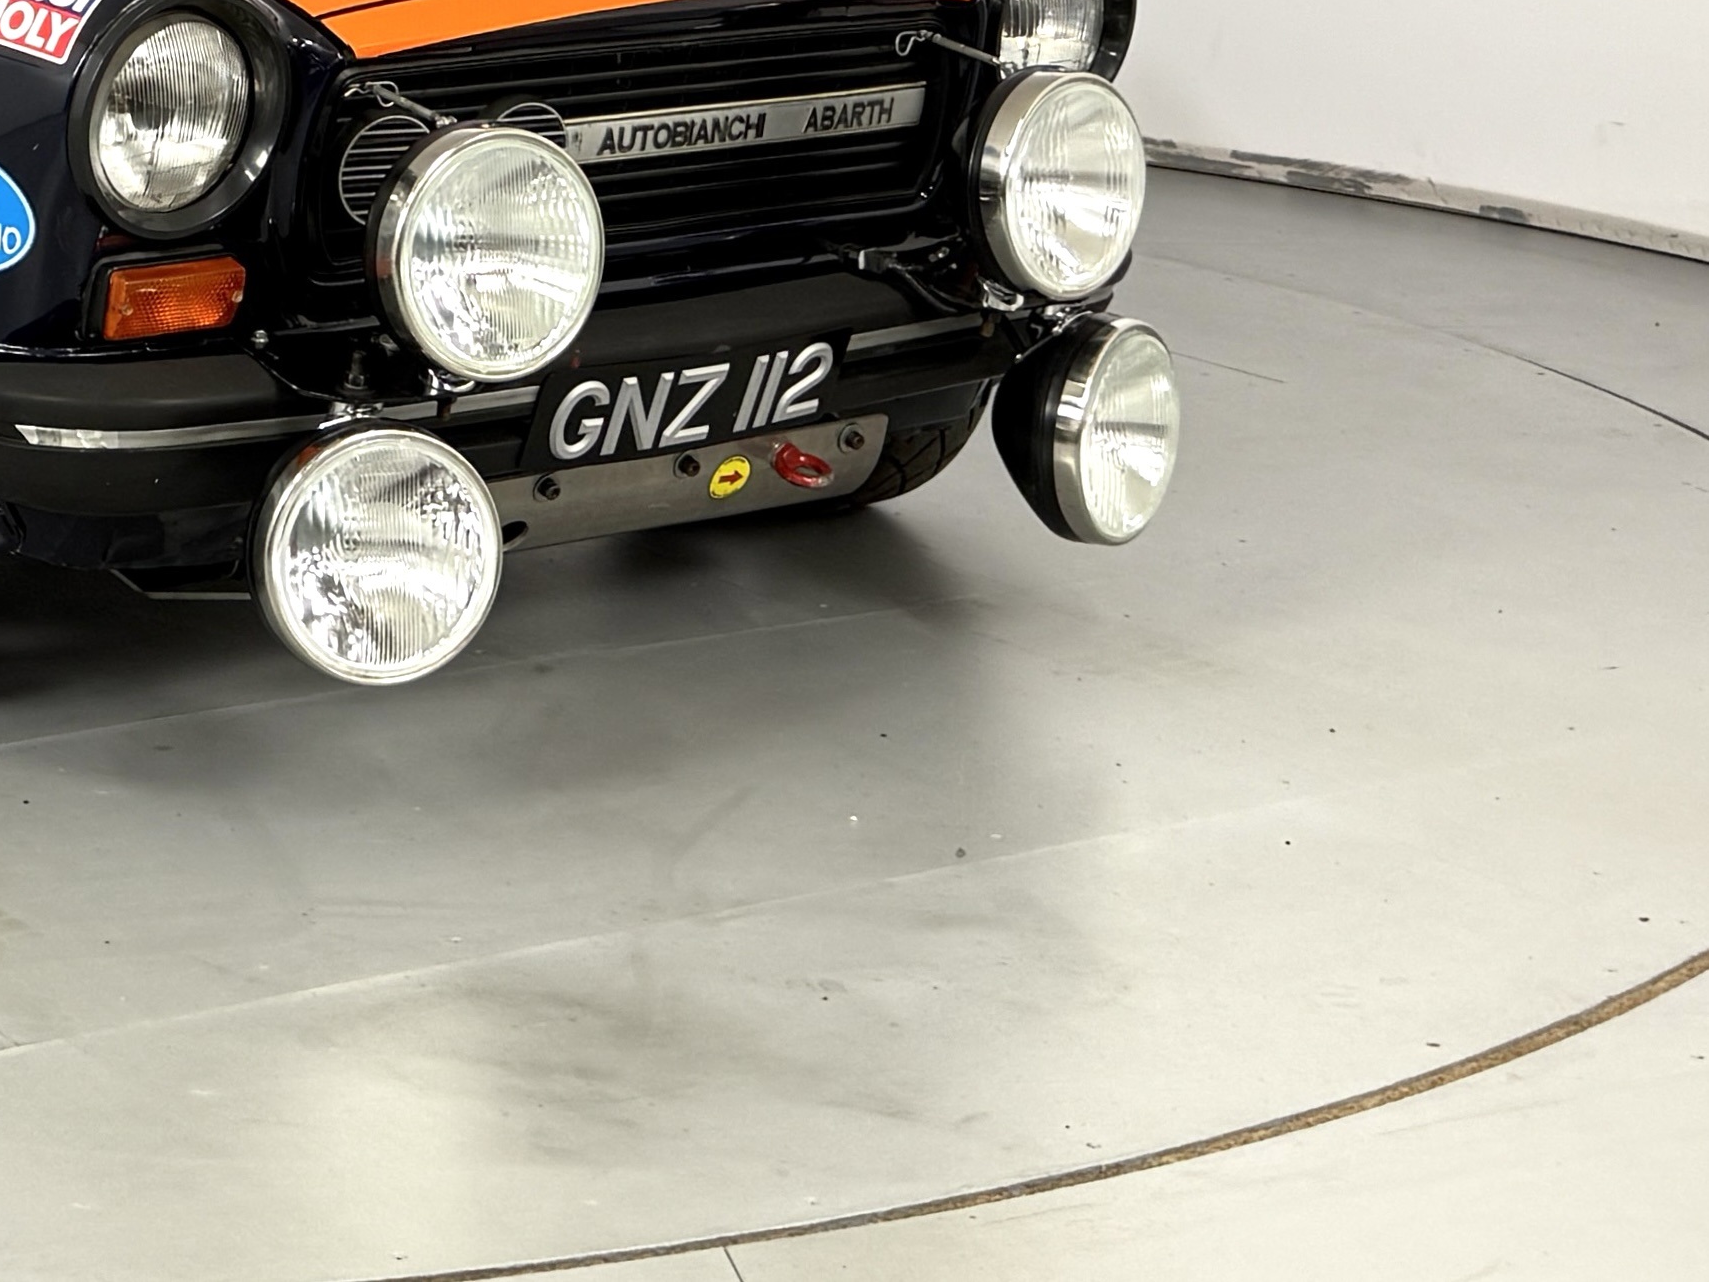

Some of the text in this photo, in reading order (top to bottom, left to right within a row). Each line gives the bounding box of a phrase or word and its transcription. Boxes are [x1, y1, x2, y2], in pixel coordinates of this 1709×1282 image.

[596, 97, 894, 156] AUTOBIANCHI ABARTH
[548, 341, 834, 460] GNZ 112
